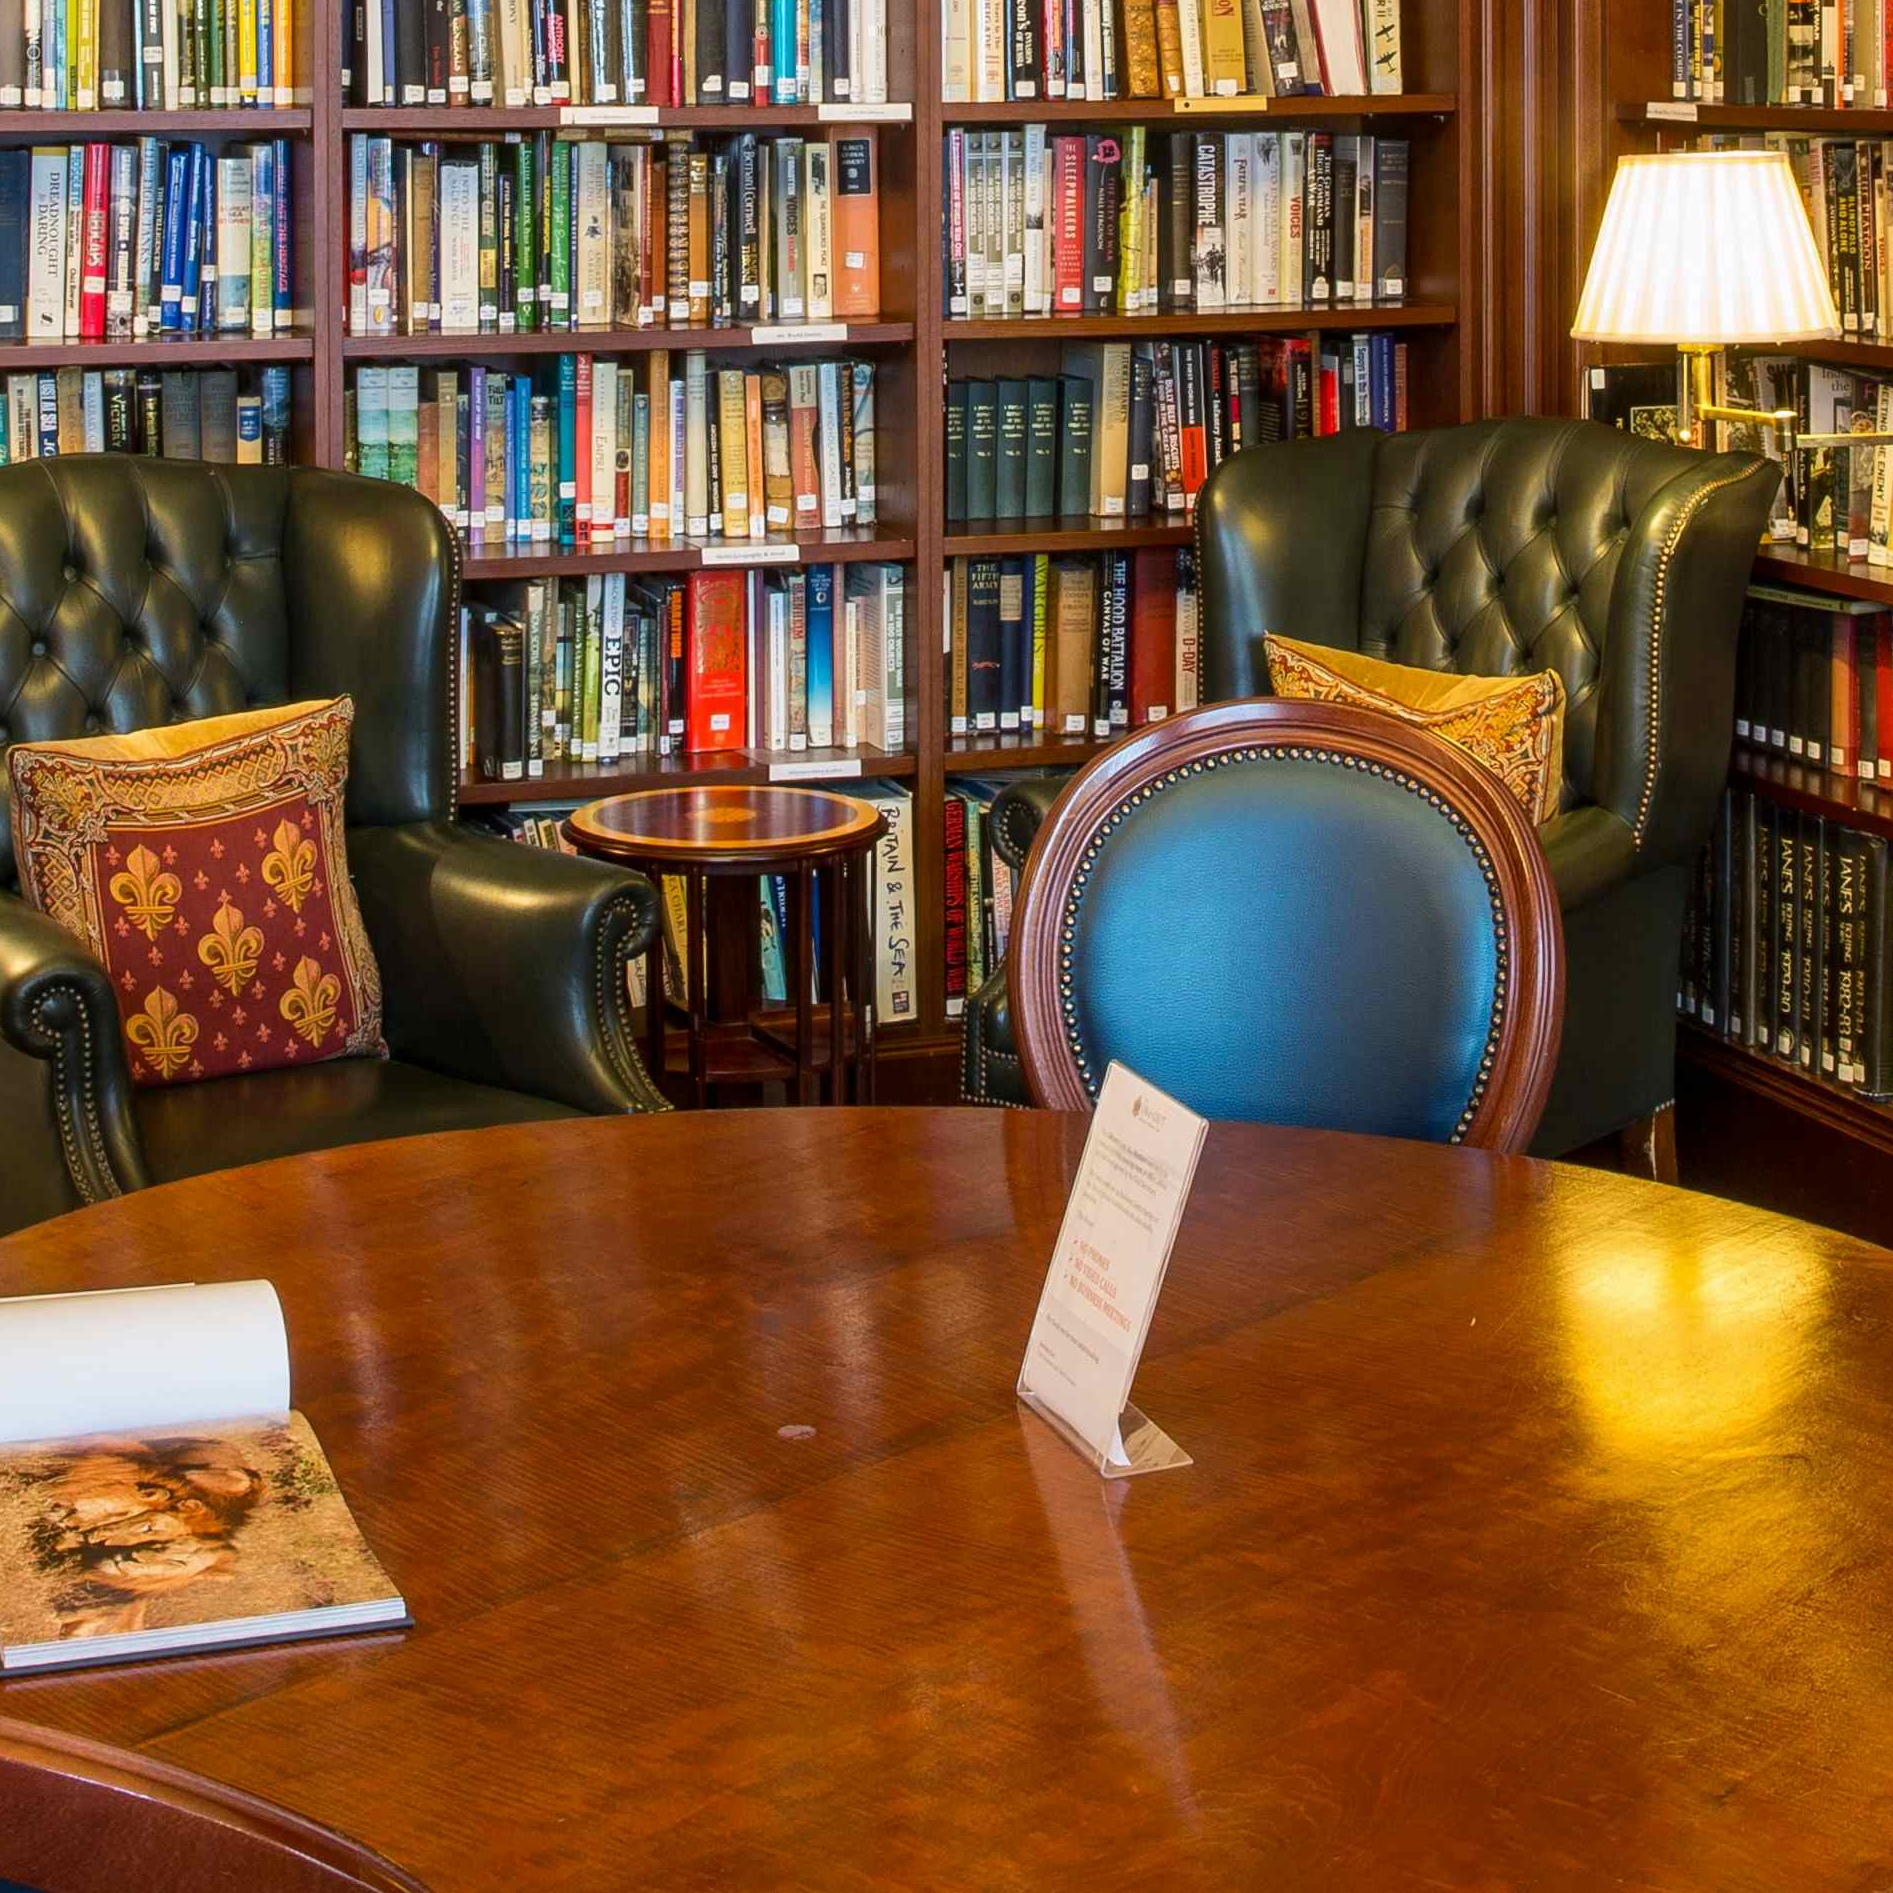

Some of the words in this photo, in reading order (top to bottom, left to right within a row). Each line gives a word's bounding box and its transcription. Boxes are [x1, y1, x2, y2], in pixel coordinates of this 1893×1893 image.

[1378, 5, 1386, 18] II
[1197, 144, 1215, 226] CATASTROPHE
[1290, 197, 1301, 239] VOICES
[605, 639, 621, 696] EPIC
[884, 806, 905, 874] BRITAIN
[887, 882, 900, 894] &
[888, 900, 903, 931] THE
[888, 937, 907, 978] SEA
